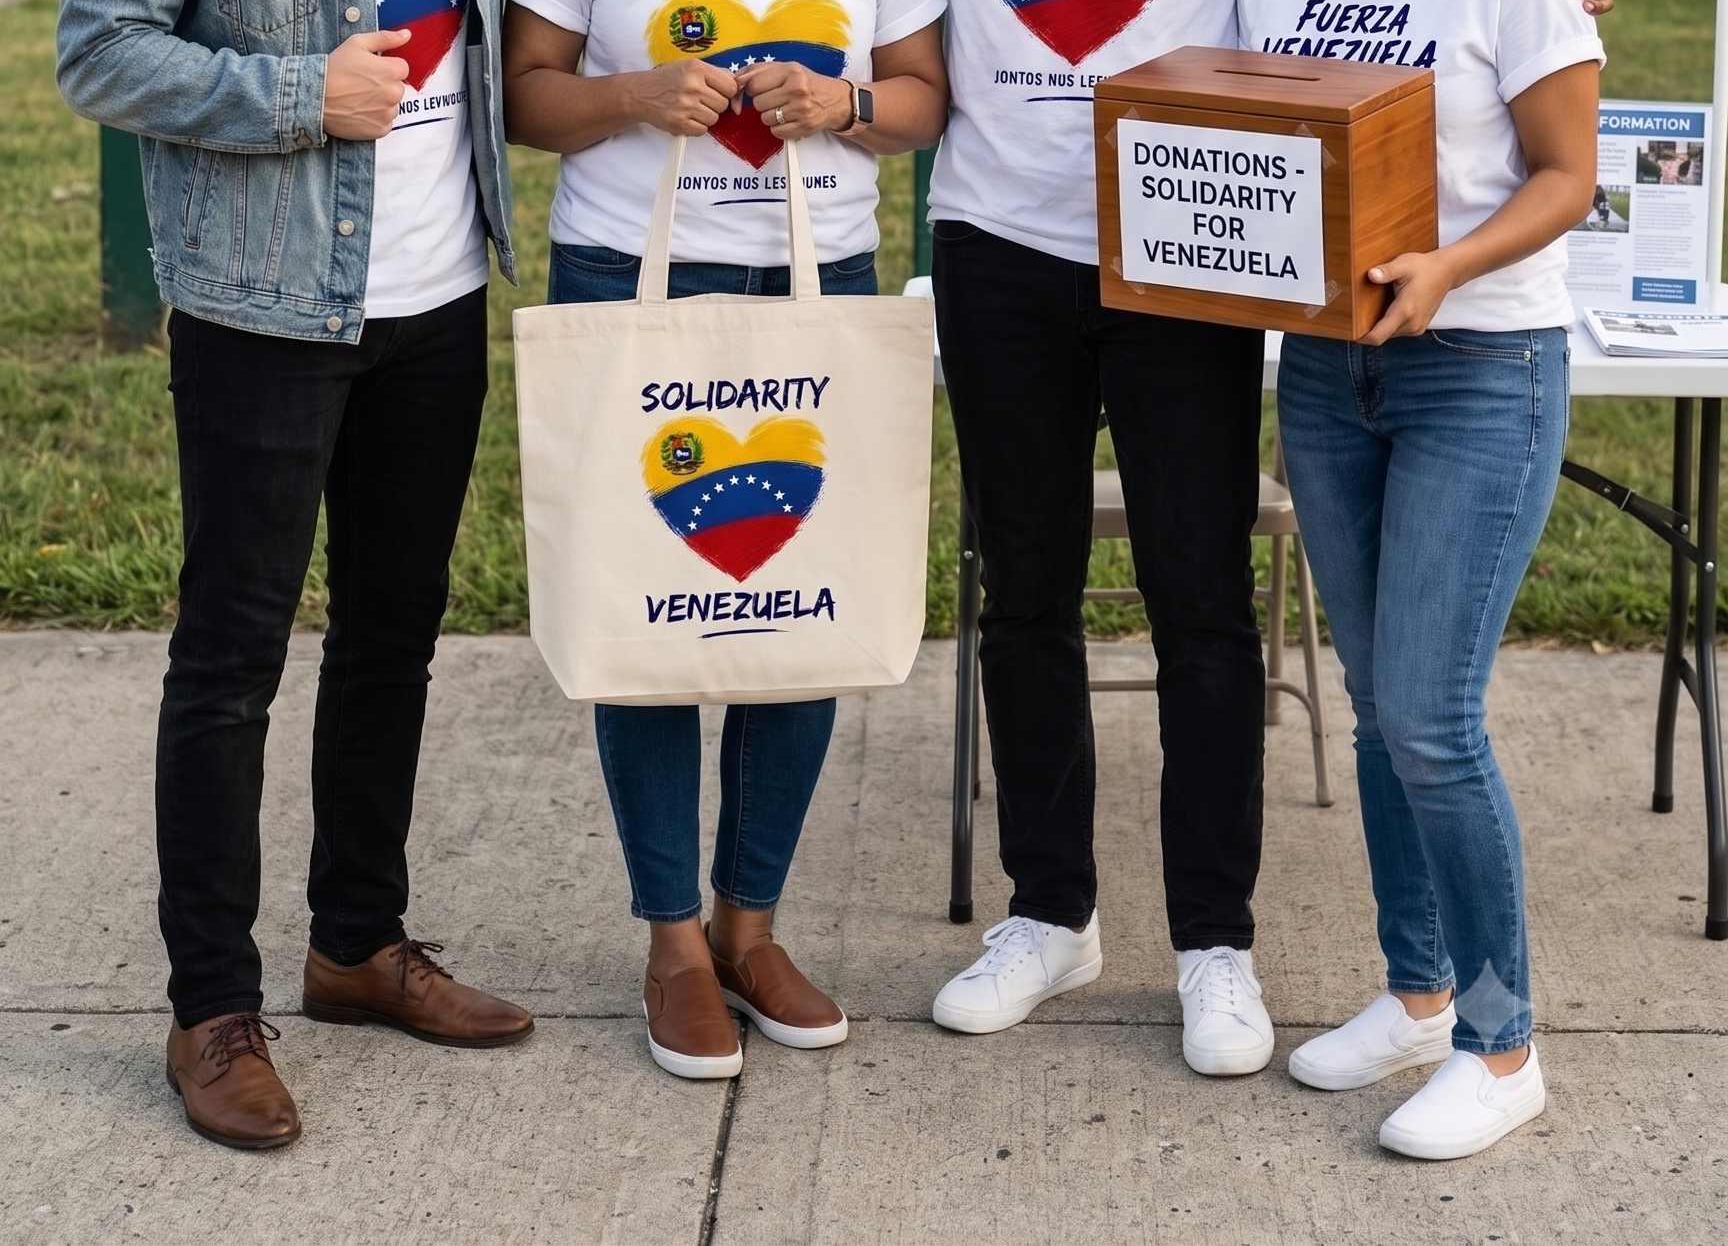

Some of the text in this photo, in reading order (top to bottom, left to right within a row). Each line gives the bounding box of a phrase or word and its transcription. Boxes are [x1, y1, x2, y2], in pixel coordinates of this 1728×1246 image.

[1133, 142, 1288, 180] DONATIONS
[1141, 175, 1297, 214] SOLIDARITY
[1192, 212, 1245, 241] FOR
[1142, 238, 1299, 280] VENEZUELA
[641, 376, 830, 413] SOLIDARITY
[645, 588, 836, 623] VENEZUELA
